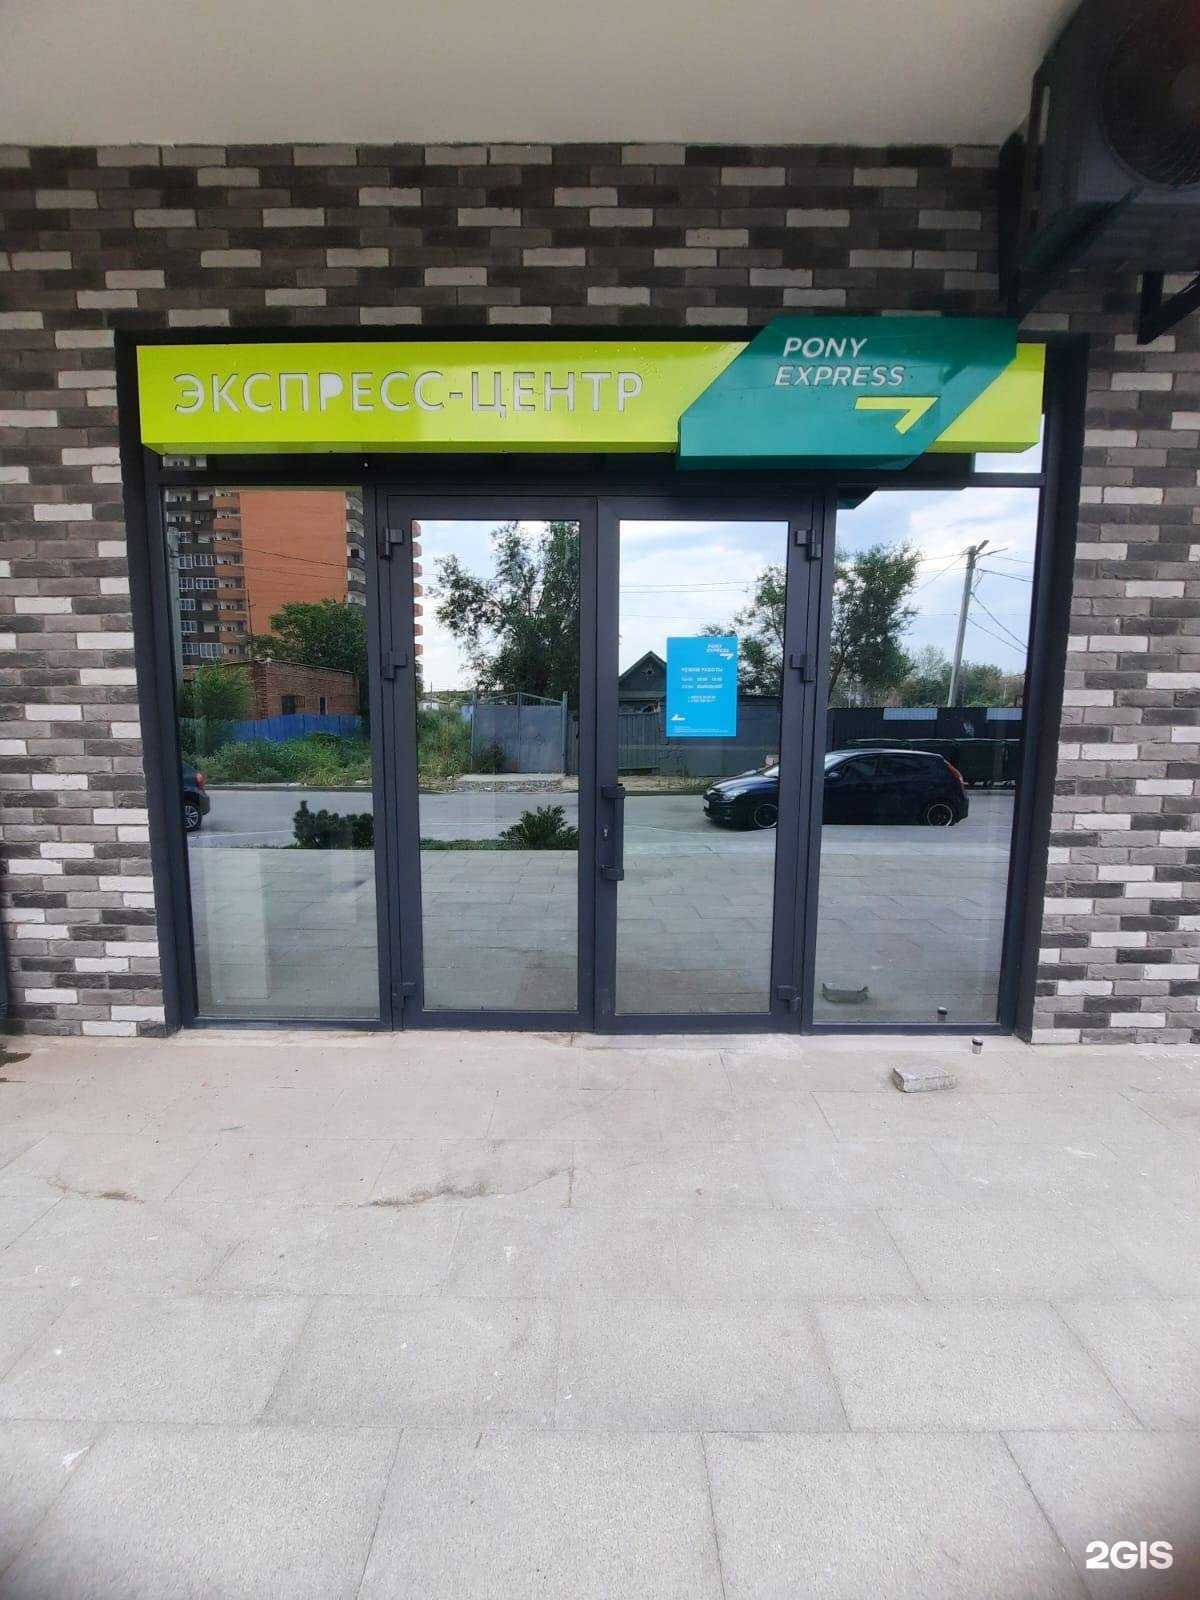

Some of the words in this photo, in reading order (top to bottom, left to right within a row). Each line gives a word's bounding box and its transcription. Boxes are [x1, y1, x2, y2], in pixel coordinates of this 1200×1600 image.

[783, 337, 868, 358] PONY
[774, 365, 906, 387] EXPRESS
[173, 371, 645, 418] ЭКСПРЕСС-ЦЕНТР
